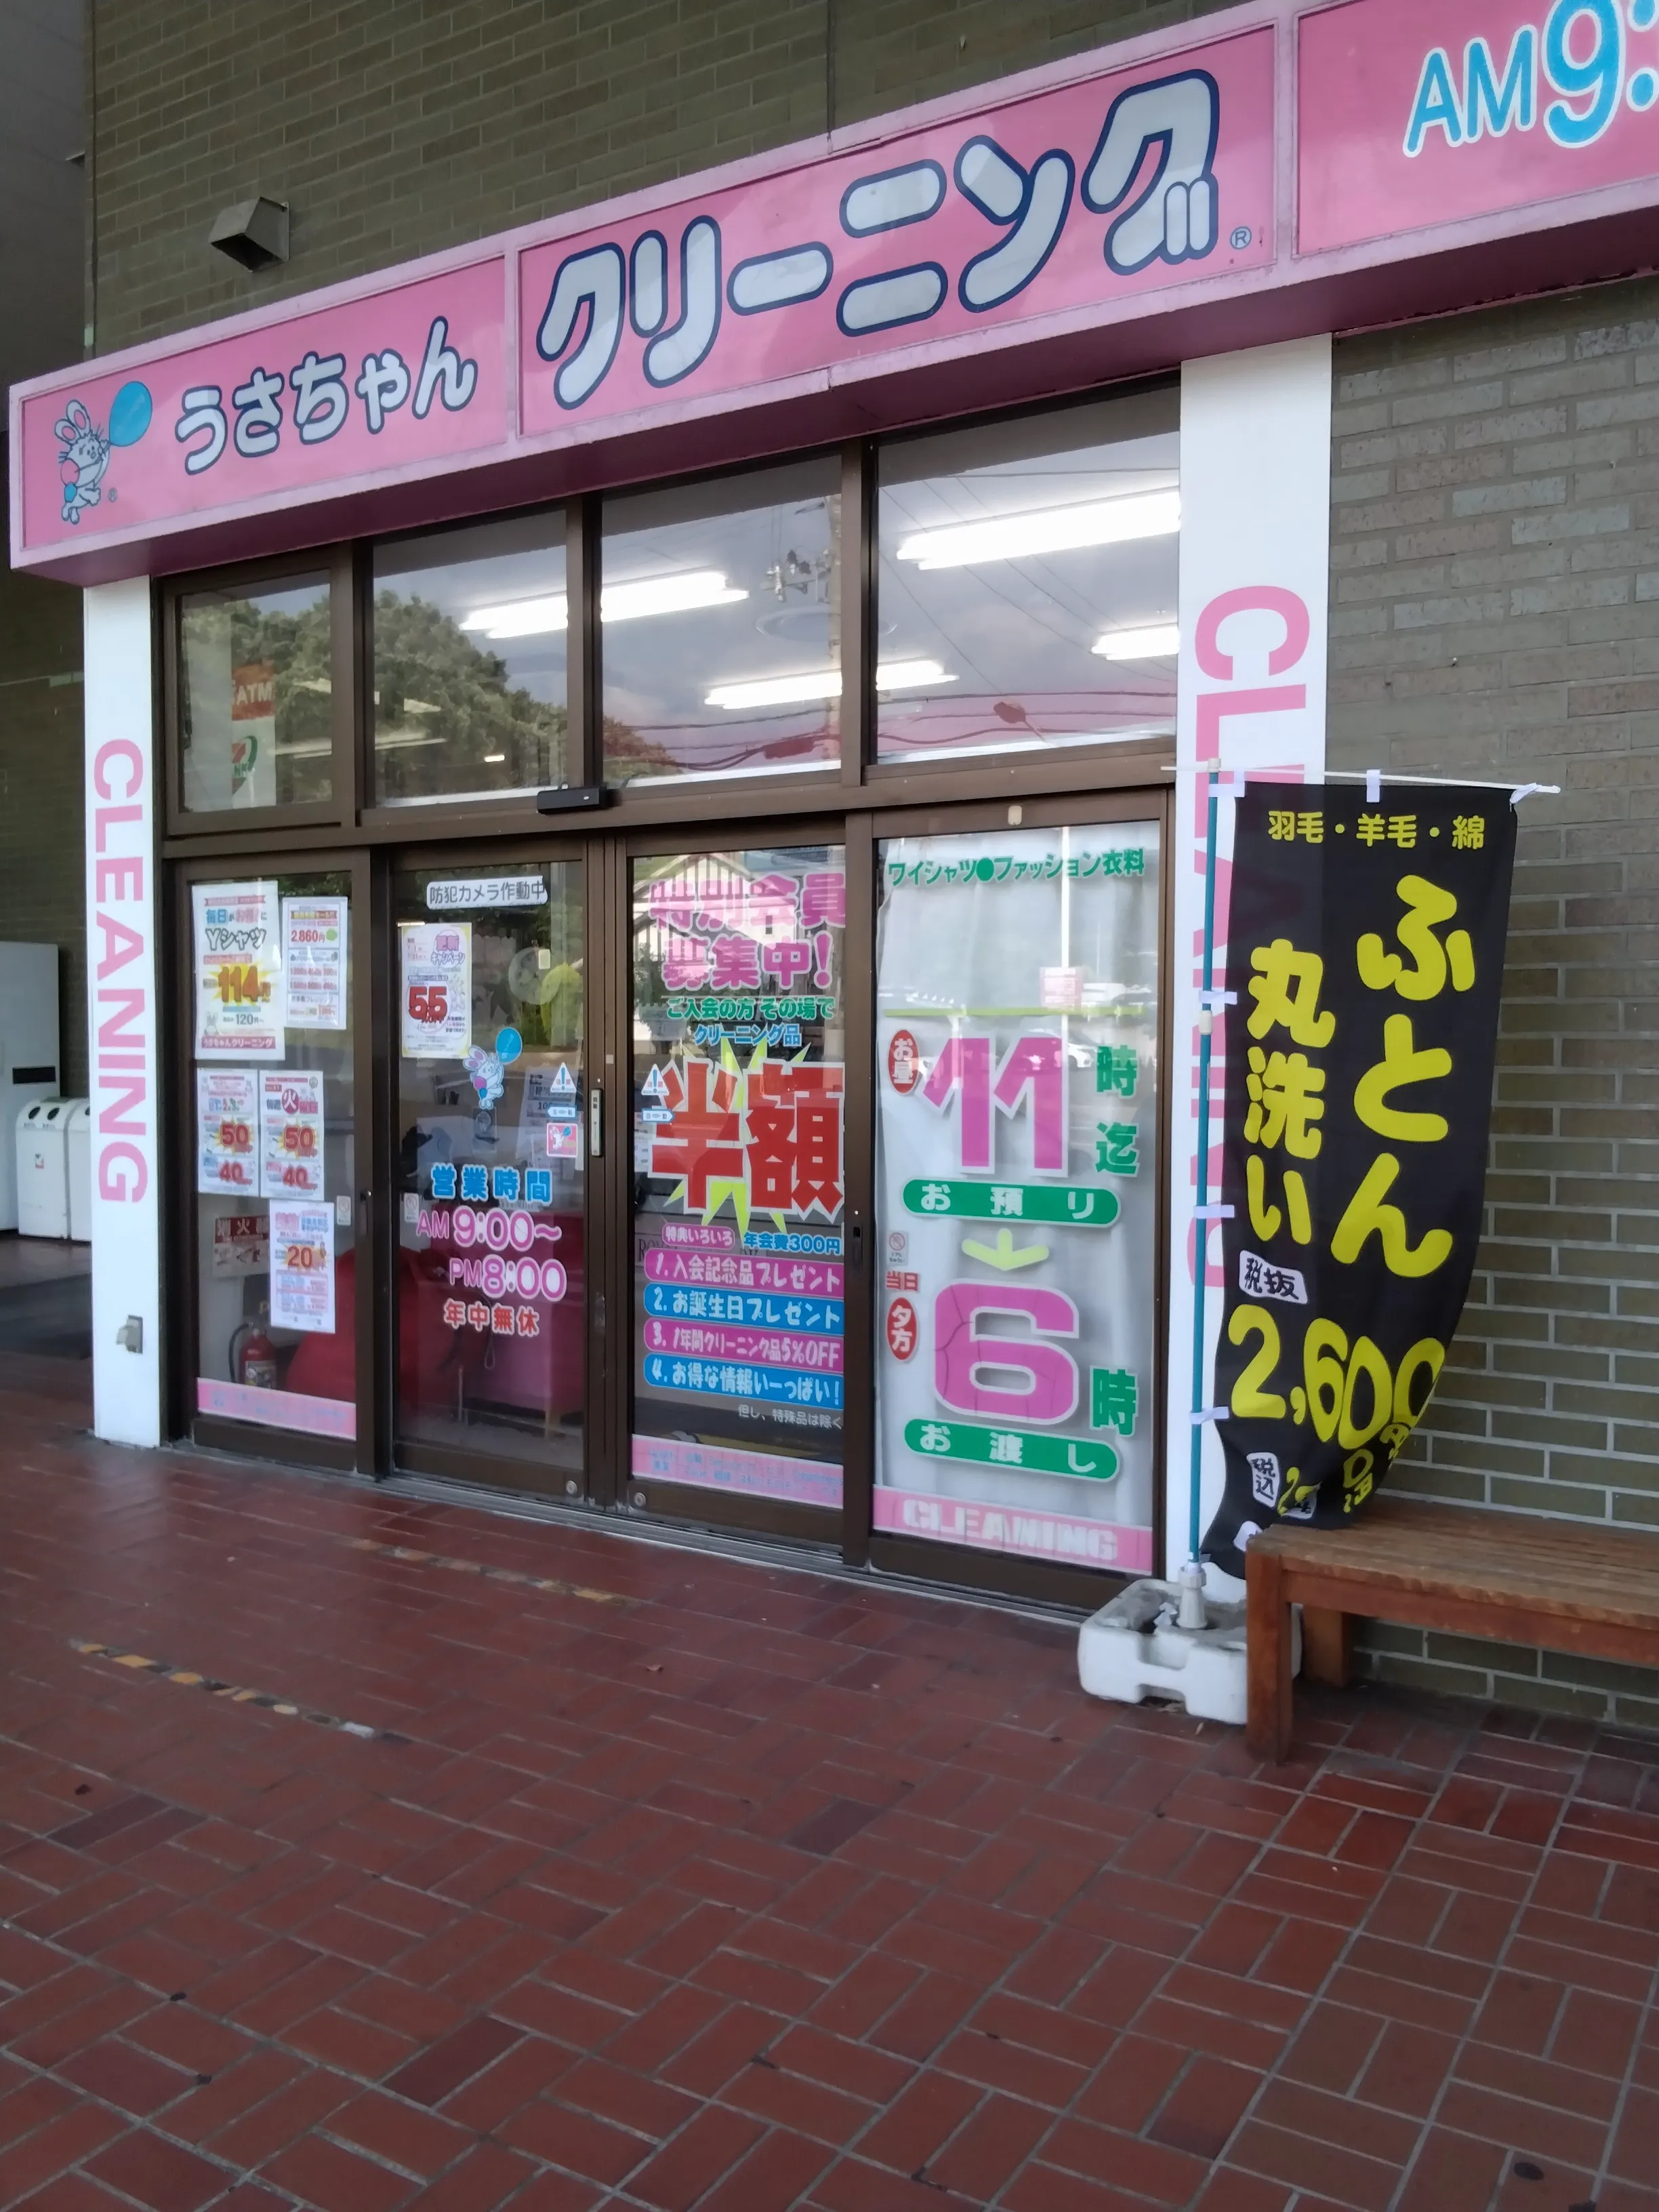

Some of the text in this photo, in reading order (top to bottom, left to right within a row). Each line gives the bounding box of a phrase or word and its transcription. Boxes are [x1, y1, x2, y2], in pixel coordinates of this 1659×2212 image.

[536, 68, 1221, 410] クリーニング
[175, 316, 478, 475] うさちゃん
[1268, 811, 1485, 850] 羽毛・羊毛・綿
[430, 881, 546, 905] 防犯カメラ作動中
[649, 872, 845, 930] 特別会員
[94, 738, 148, 1204] CLEANING
[694, 1023, 802, 1048] クリーニング品
[1244, 939, 1336, 1245] 丸洗い
[1331, 875, 1475, 1278] ふとん
[648, 1058, 844, 1224] 半額
[431, 1164, 552, 1205] 営業時間
[921, 1183, 1095, 1218] お預り
[665, 1225, 733, 1246] 特典いろいろ
[743, 1231, 842, 1255] 年会費300円
[287, 1246, 313, 1268] 20
[886, 1270, 918, 1291] 当日
[1244, 1258, 1299, 1300] 税抜
[444, 1298, 539, 1336] 年中無休
[891, 1304, 912, 1352] 夕方
[920, 1423, 1097, 1473] お渡し
[903, 1498, 1118, 1560] CLEANING
